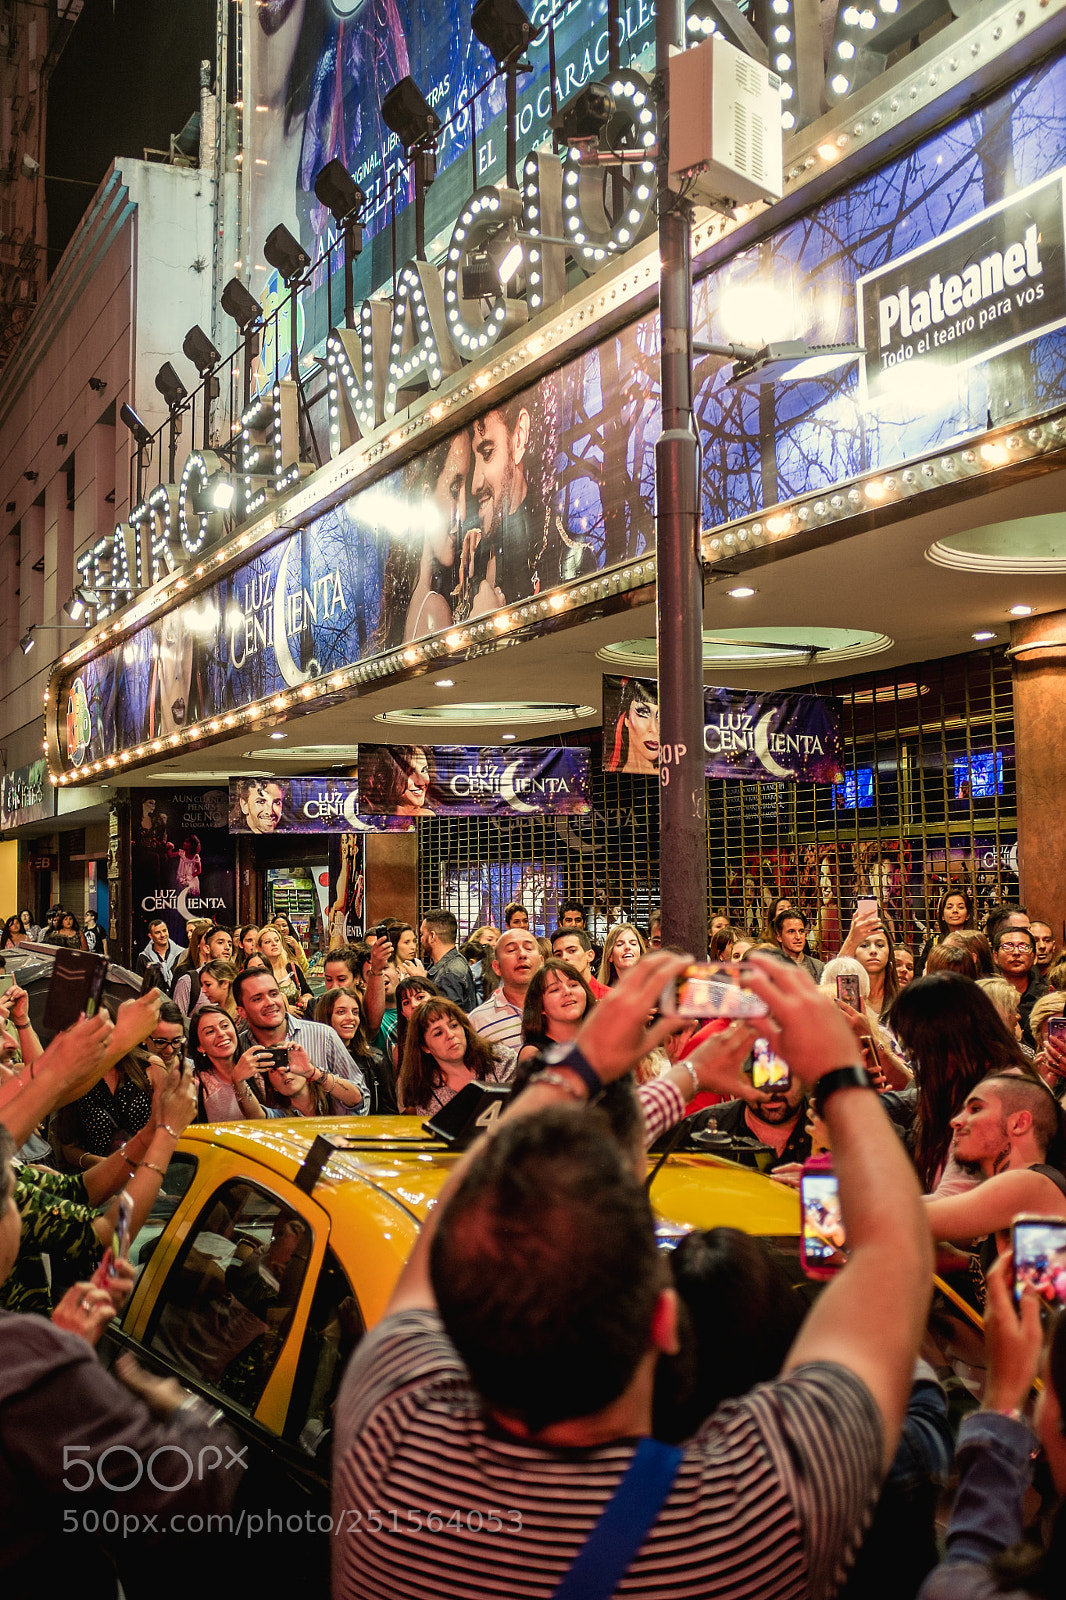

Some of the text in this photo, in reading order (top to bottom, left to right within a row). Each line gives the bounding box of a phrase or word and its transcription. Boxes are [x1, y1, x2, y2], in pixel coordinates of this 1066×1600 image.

[478, 139, 497, 176] EL
[878, 223, 1043, 347] Plateanet
[881, 283, 1045, 369] Todo el teatro para vos
[76, 449, 222, 627] TEATRO
[242, 381, 316, 516] EL
[244, 570, 273, 616] LUZ
[719, 713, 754, 731] LUZ
[468, 765, 500, 779] LUZ
[318, 793, 344, 804] LUZ
[154, 889, 177, 899] LUZ
